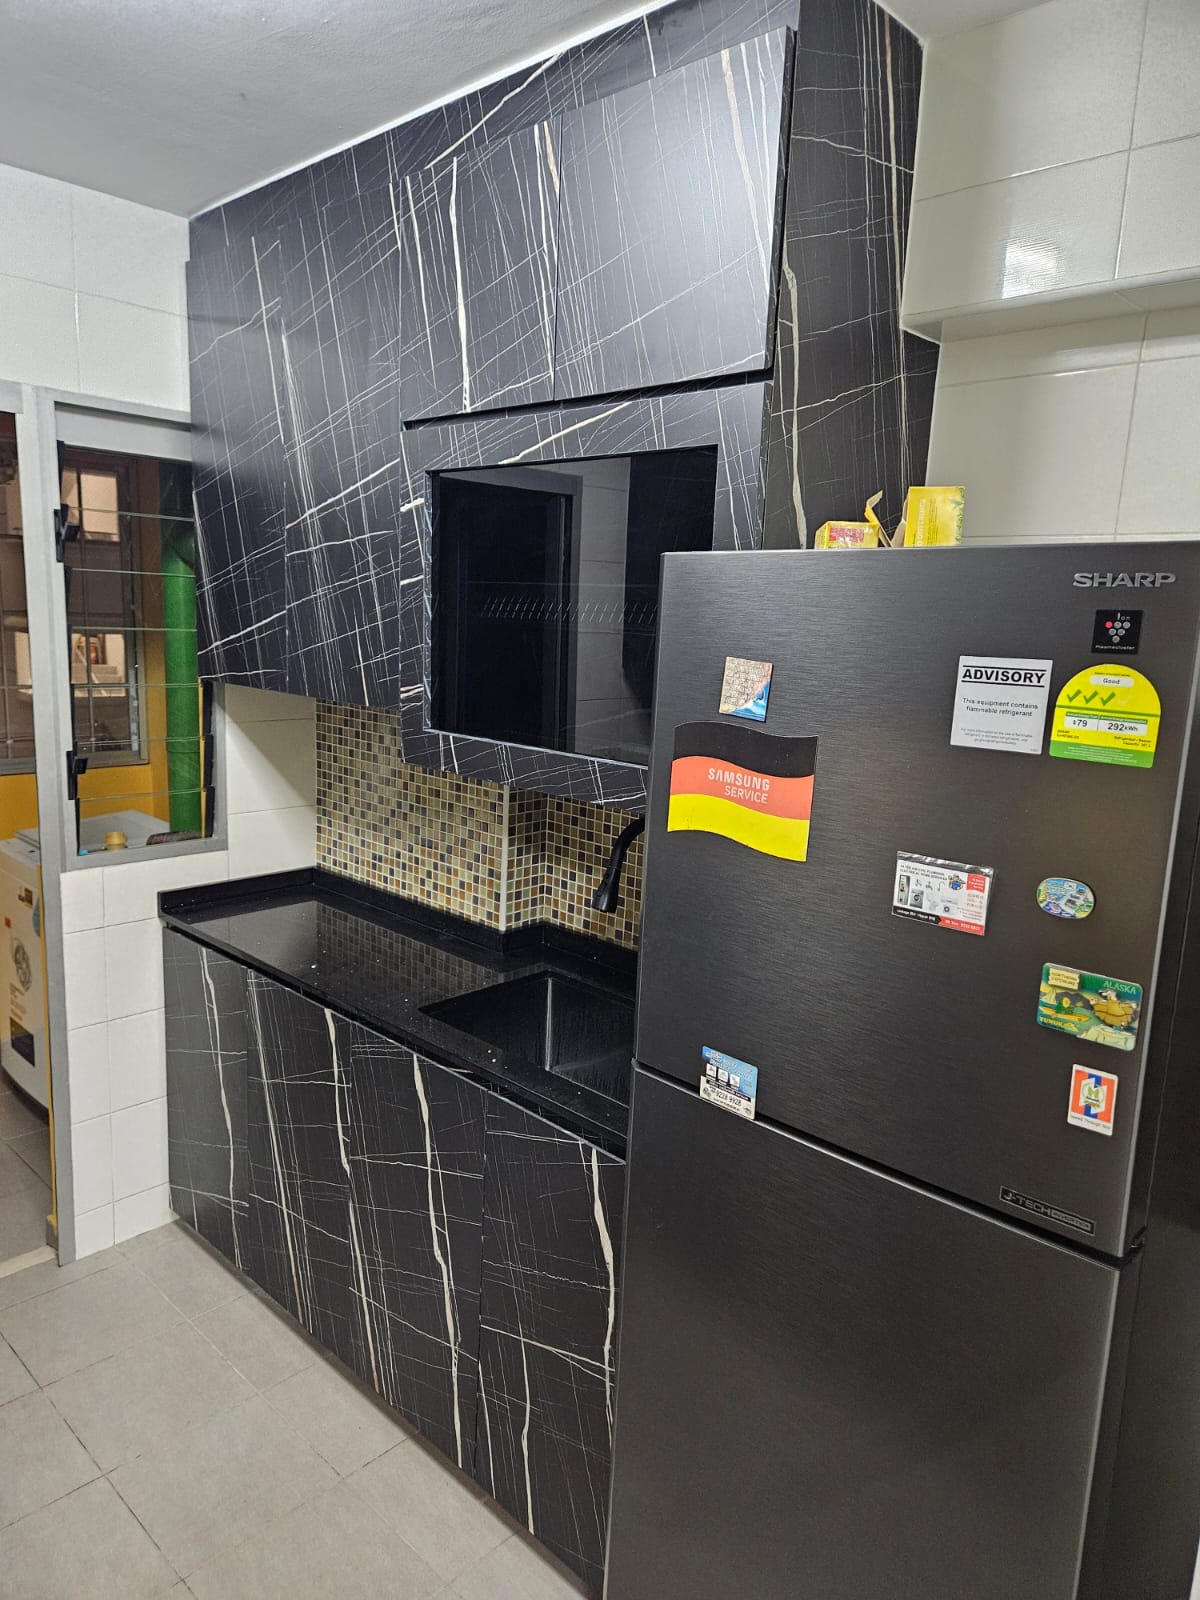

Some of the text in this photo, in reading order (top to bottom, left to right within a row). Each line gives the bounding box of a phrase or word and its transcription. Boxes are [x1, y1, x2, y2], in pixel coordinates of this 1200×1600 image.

[1073, 572, 1177, 588] SHARP
[962, 668, 1045, 684] ADVISORY
[966, 705, 1033, 717] flammable refrigerant
[977, 699, 1010, 708] equipment
[1010, 701, 1039, 710] contains
[708, 767, 770, 791] SAMSUNG
[724, 785, 769, 804] SERVICE
[1103, 980, 1137, 995] ALASKA
[1003, 1192, 1051, 1216] J-TECH
